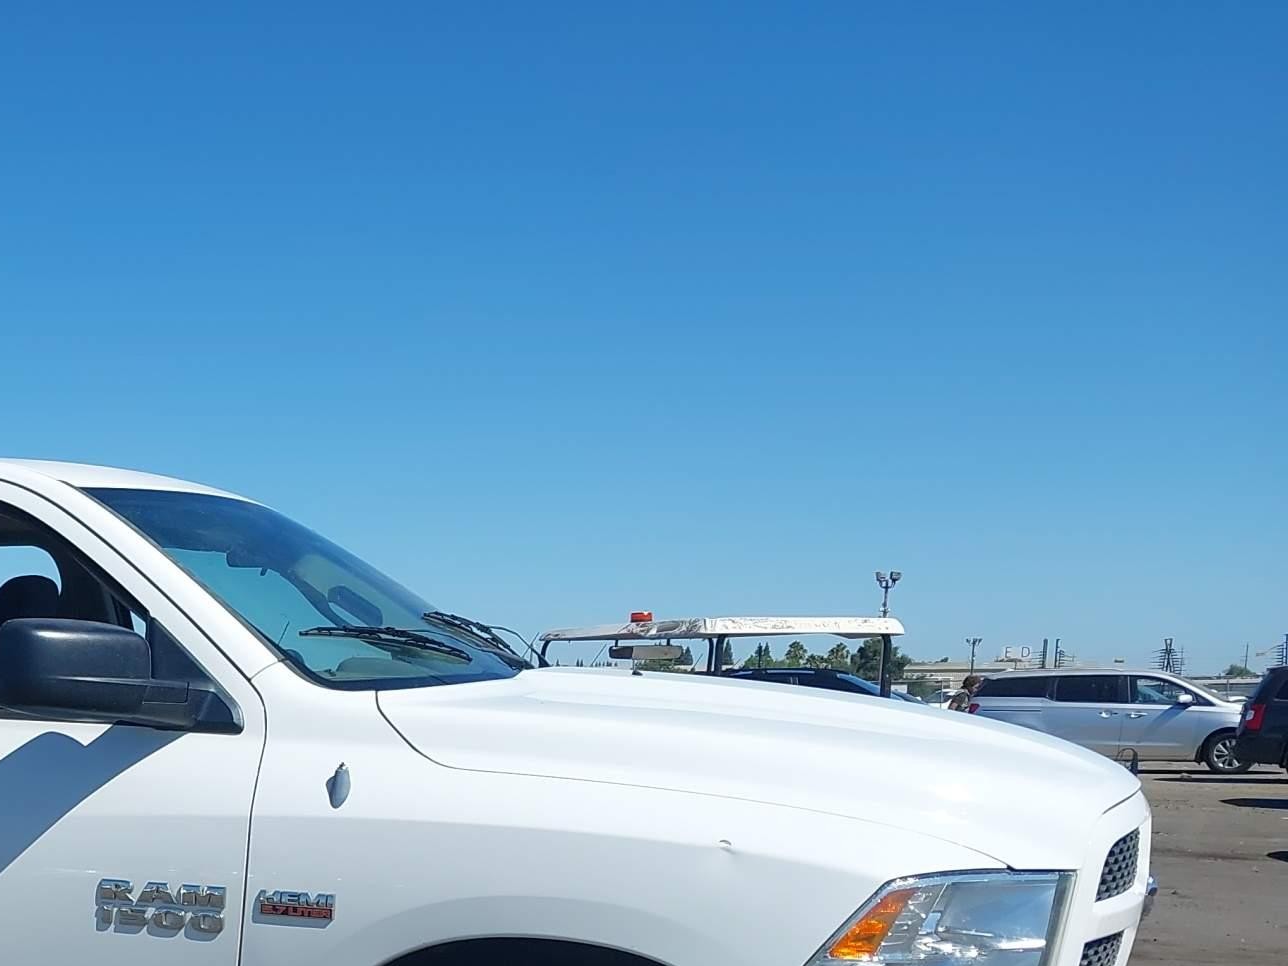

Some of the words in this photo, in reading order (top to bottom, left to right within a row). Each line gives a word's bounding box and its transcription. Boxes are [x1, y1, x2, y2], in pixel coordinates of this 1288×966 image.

[97, 878, 226, 909] RAM
[258, 888, 337, 908] HEMI
[97, 904, 226, 939] 1500
